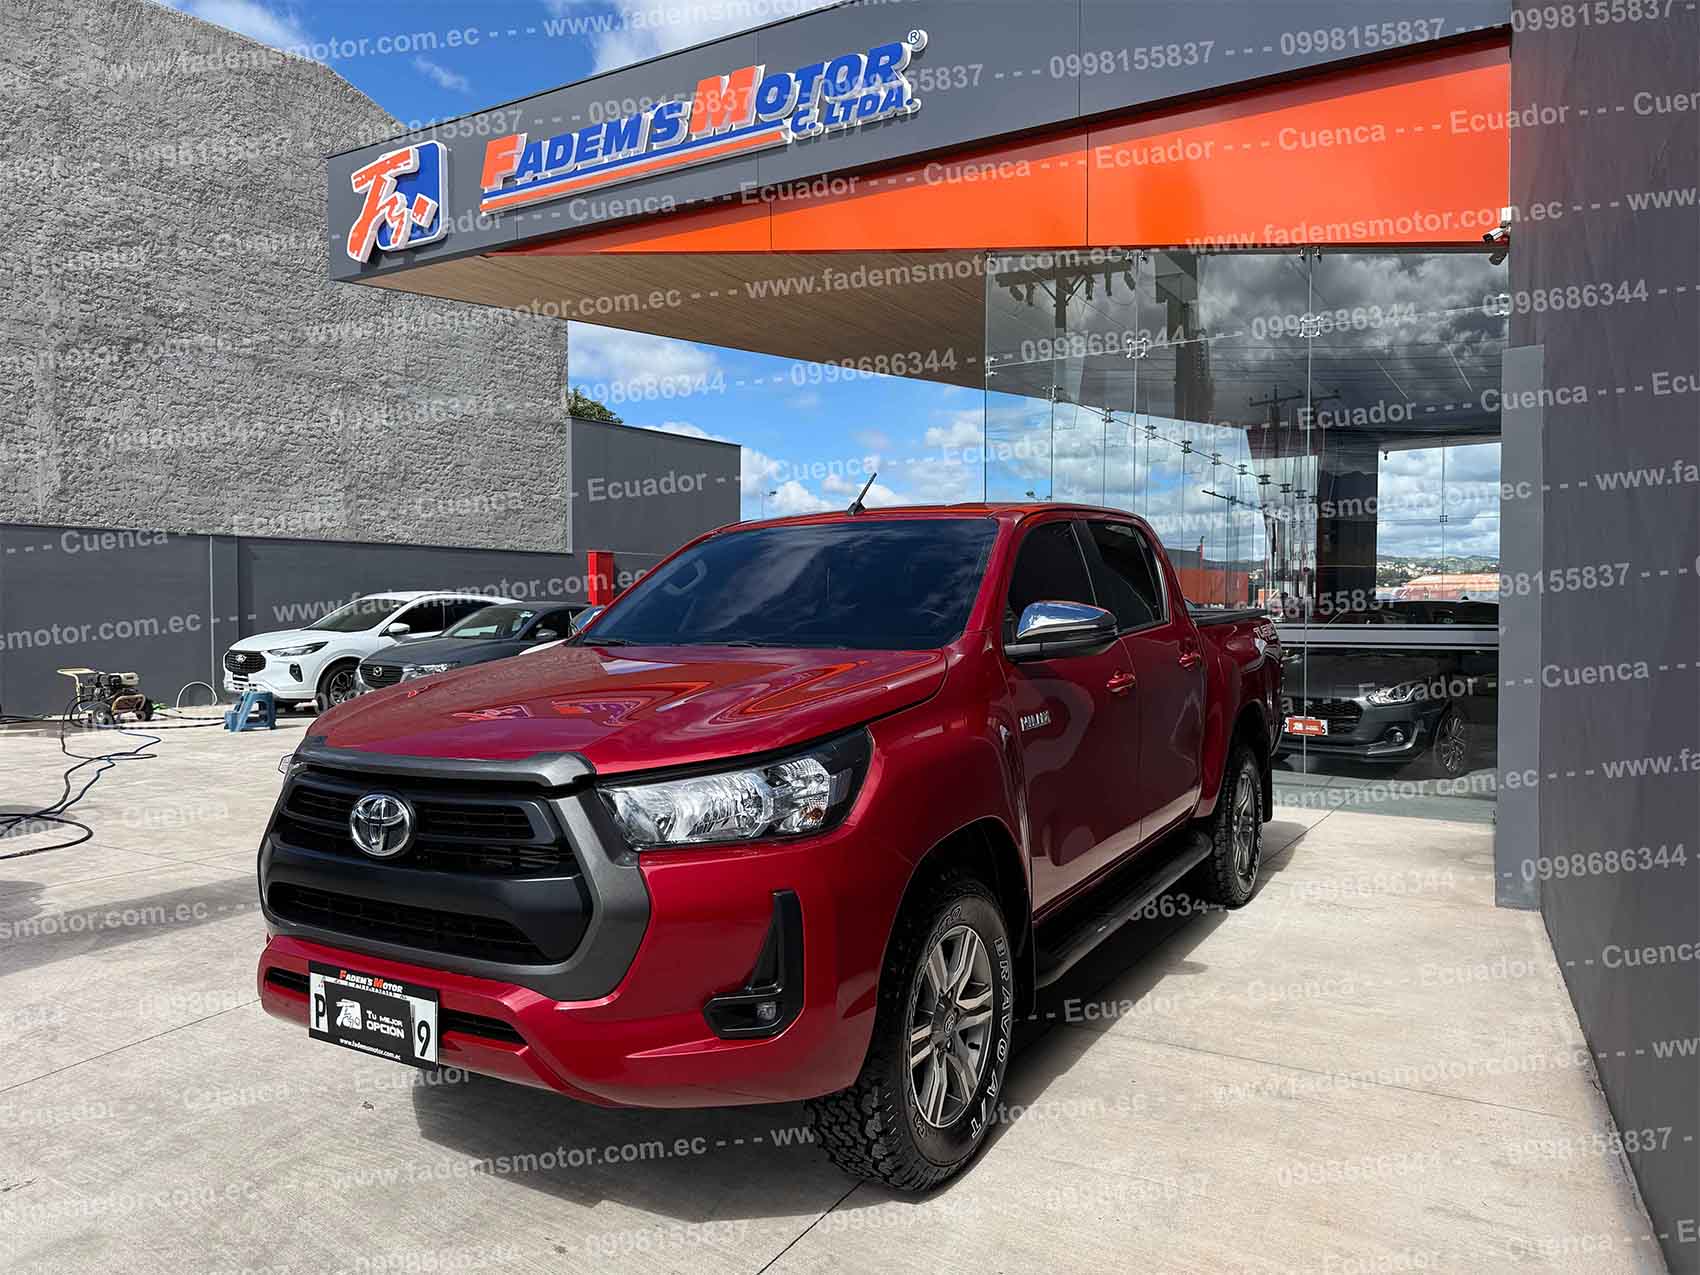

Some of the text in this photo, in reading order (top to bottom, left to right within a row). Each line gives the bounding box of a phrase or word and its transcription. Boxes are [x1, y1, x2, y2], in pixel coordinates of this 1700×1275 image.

[690, 42, 912, 135] MOTOR
[824, 83, 921, 128] LTDA.
[373, 977, 403, 993] MOTOR
[993, 936, 1012, 1063] BRAVO
[314, 993, 326, 1028] P
[417, 1020, 431, 1057] 9
